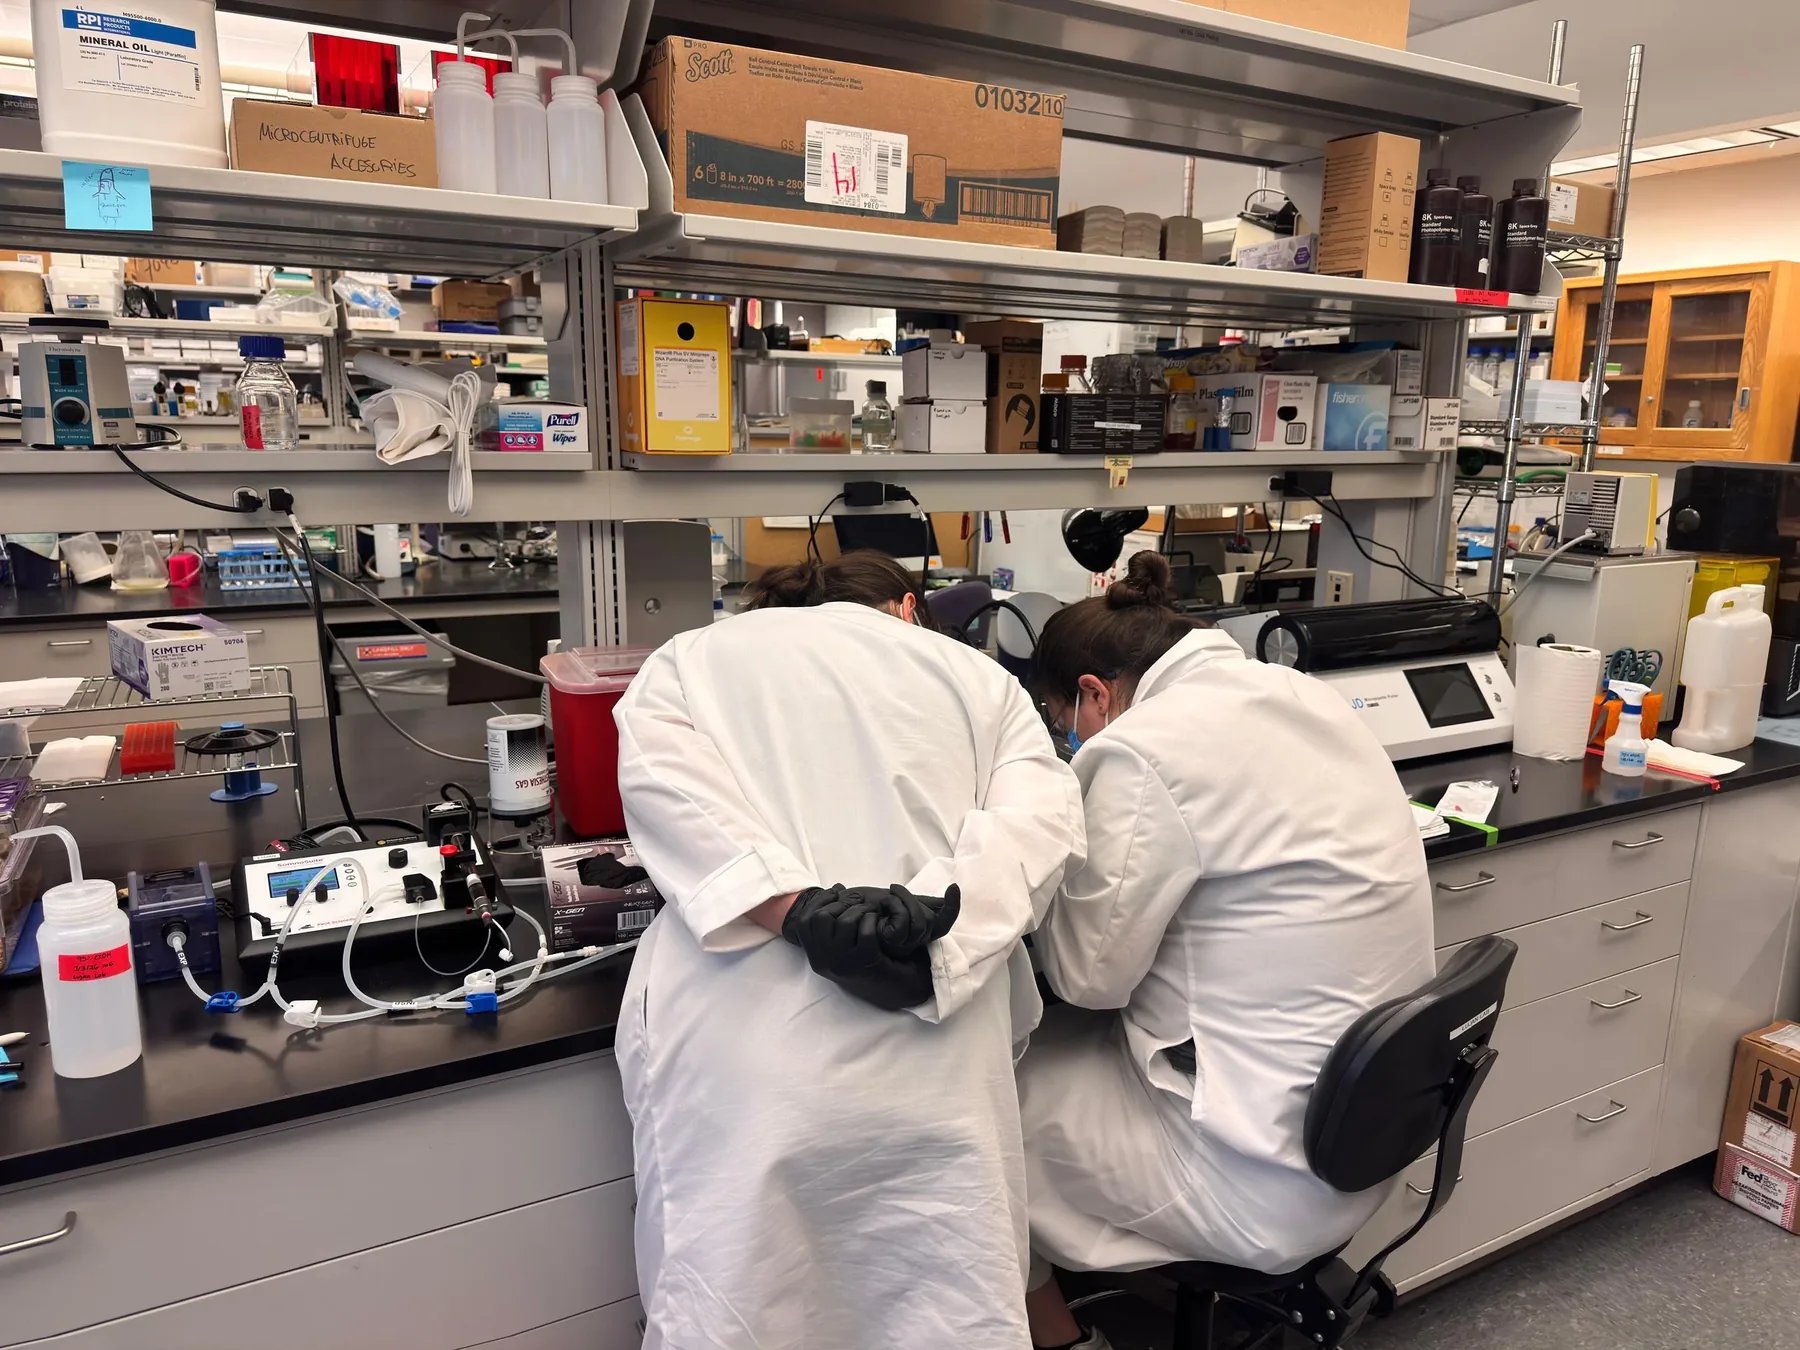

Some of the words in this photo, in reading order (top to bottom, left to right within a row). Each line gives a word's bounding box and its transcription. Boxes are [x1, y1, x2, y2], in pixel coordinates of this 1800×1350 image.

[77, 12, 102, 26] RPI
[103, 16, 130, 25] RESEARCH
[103, 21, 131, 30] PRODUCTS
[79, 35, 129, 49] MINERAL
[132, 42, 150, 52] OIL
[151, 48, 164, 56] Light
[693, 41, 708, 49] PRO
[120, 55, 141, 63] Laboratory
[142, 56, 154, 64] Grade
[685, 48, 733, 83] Scott
[974, 84, 1041, 116] 01032
[1045, 98, 1063, 115] 10
[694, 165, 704, 180] 6
[720, 171, 726, 181] 8
[728, 172, 737, 182] in
[747, 174, 764, 185] 700
[766, 176, 774, 186] ft
[1422, 213, 1432, 221] 8K
[1507, 222, 1518, 230] 8K
[550, 414, 577, 426] Purell
[552, 433, 577, 446] Wipes
[224, 638, 244, 646] 50706
[151, 644, 204, 656] KIMTECH
[515, 779, 529, 789] GAS
[554, 907, 586, 916] X-GEN
[177, 952, 188, 966] EXP
[270, 945, 280, 965] EXP
[1741, 1164, 1778, 1191] FedEx
